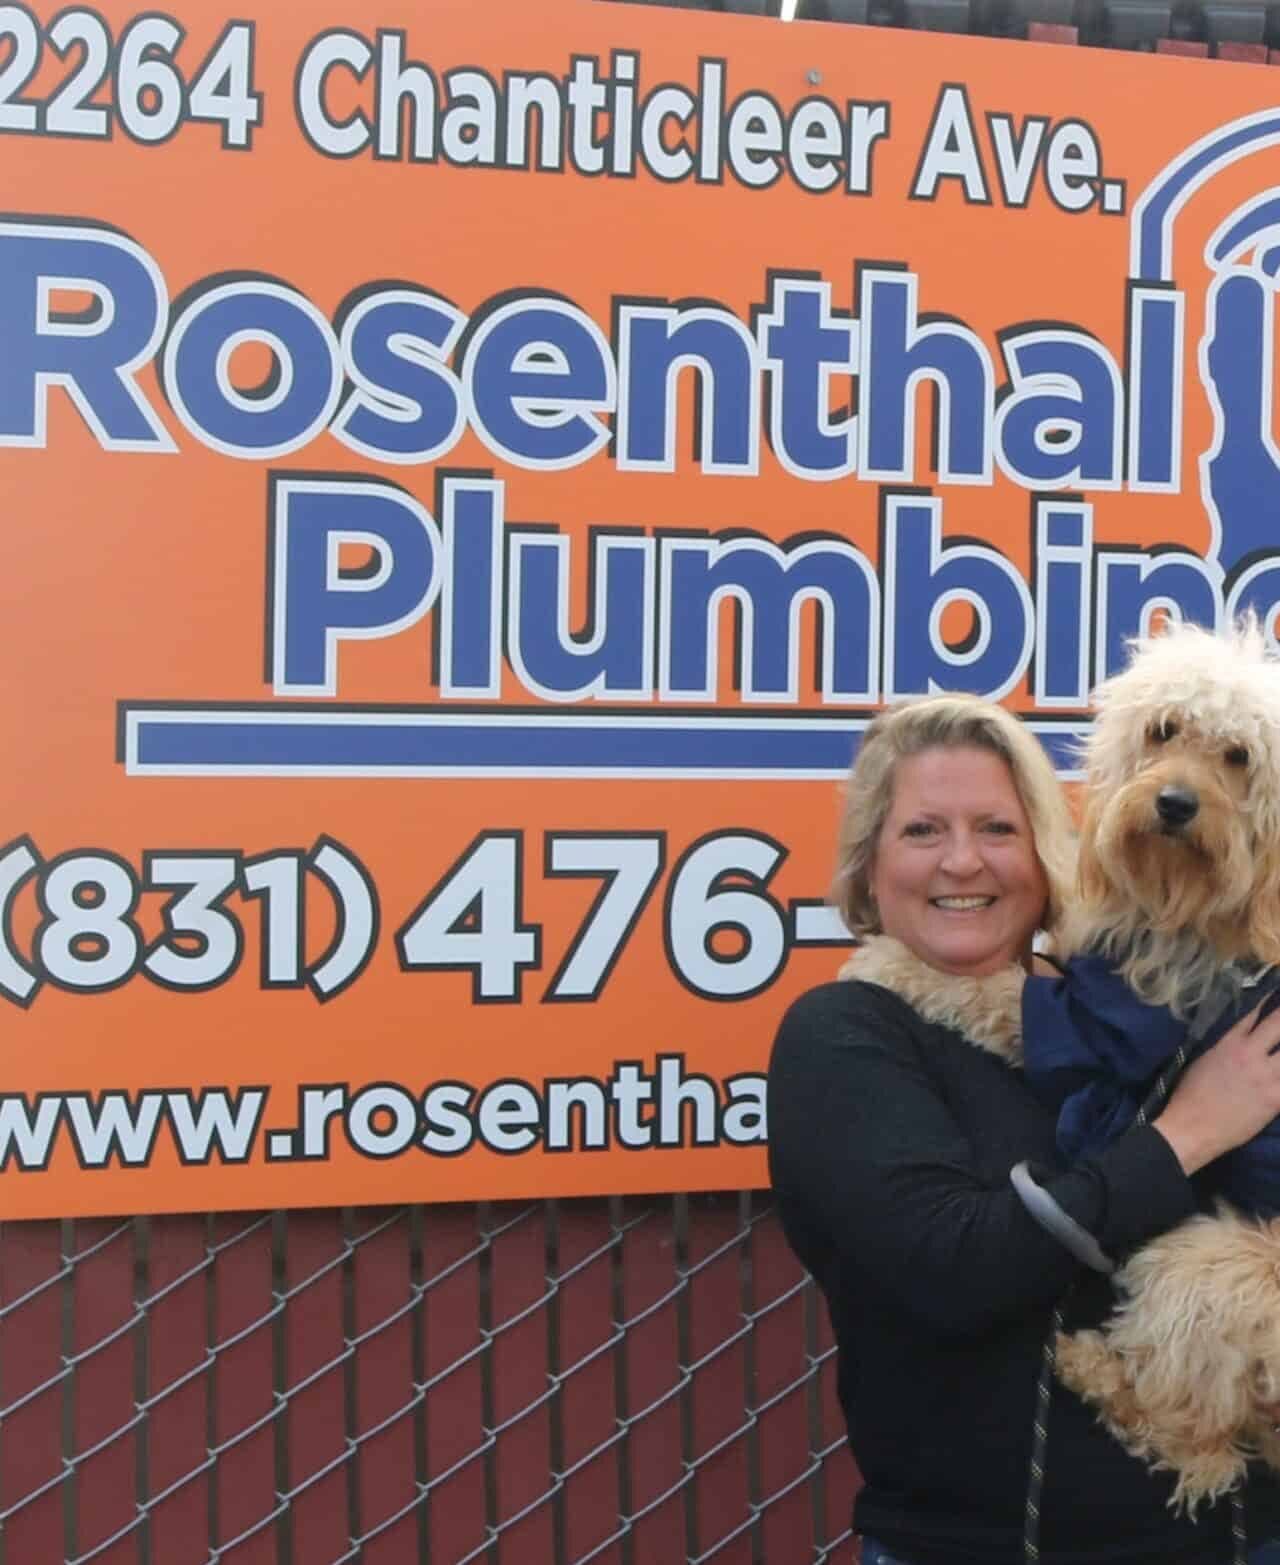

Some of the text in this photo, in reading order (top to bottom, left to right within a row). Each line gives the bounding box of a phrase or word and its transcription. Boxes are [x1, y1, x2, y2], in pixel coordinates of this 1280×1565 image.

[0, 3, 1127, 214] 2264 Chanticleer Ave.
[0, 212, 1185, 493] Rosenthal
[0, 829, 860, 1010] (831) 476-
[0, 1053, 769, 1172] www.rosentha
